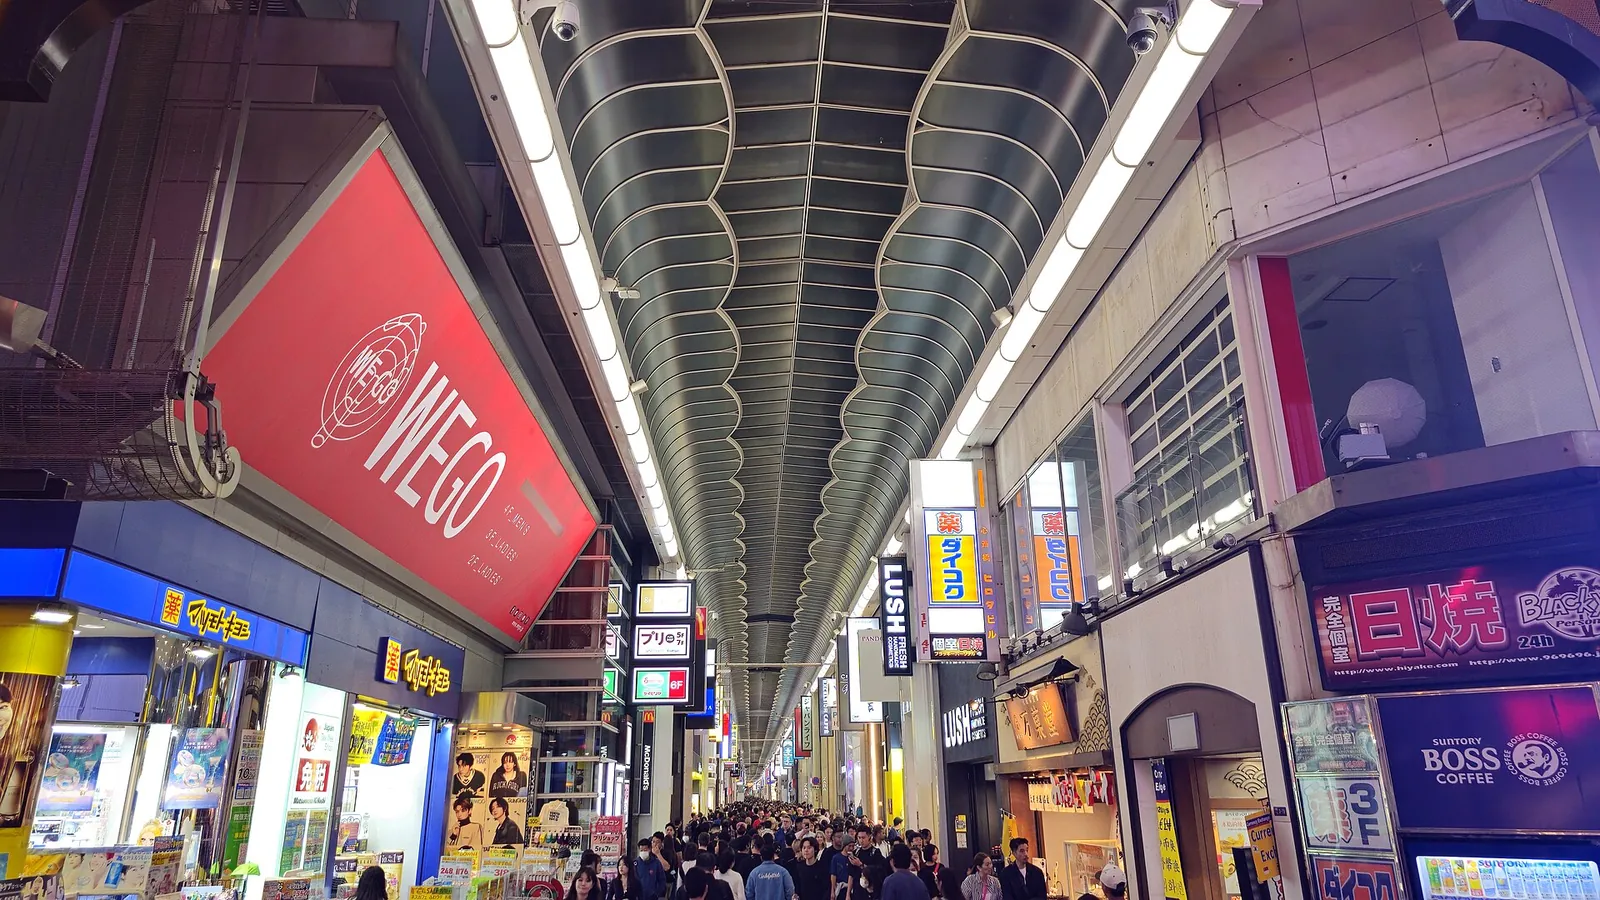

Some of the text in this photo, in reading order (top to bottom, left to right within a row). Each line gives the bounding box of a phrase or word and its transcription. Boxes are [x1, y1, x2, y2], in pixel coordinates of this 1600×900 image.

[363, 361, 506, 539] WEGO
[938, 513, 962, 533] 薬
[941, 538, 964, 599] ダイコク
[163, 592, 182, 623] 薬
[884, 564, 905, 633] LUSH
[984, 574, 996, 639] ヒロタビル
[1350, 580, 1506, 656] 日焼
[188, 600, 250, 642] マツモトキヨシ
[1323, 595, 1350, 664] 完全個室
[1518, 634, 1554, 648] 24h
[386, 642, 400, 680] 薬
[899, 637, 907, 668] FRESH
[932, 638, 983, 651] 個室日焼
[670, 680, 683, 689] 6F
[1334, 662, 1458, 676] http://www.hiyake.com
[803, 698, 811, 748] ジャパンライフ
[943, 703, 971, 748] LUSH
[299, 762, 328, 791] 免税
[642, 745, 651, 791] McDonald's
[1421, 747, 1501, 771] BOSS
[1436, 773, 1494, 784] COFFEE
[1504, 732, 1568, 786] BOSS COFFEE BOSS COFFEE BOSS COFFEE
[1350, 782, 1380, 845] 3F
[1251, 827, 1272, 842] Curre
